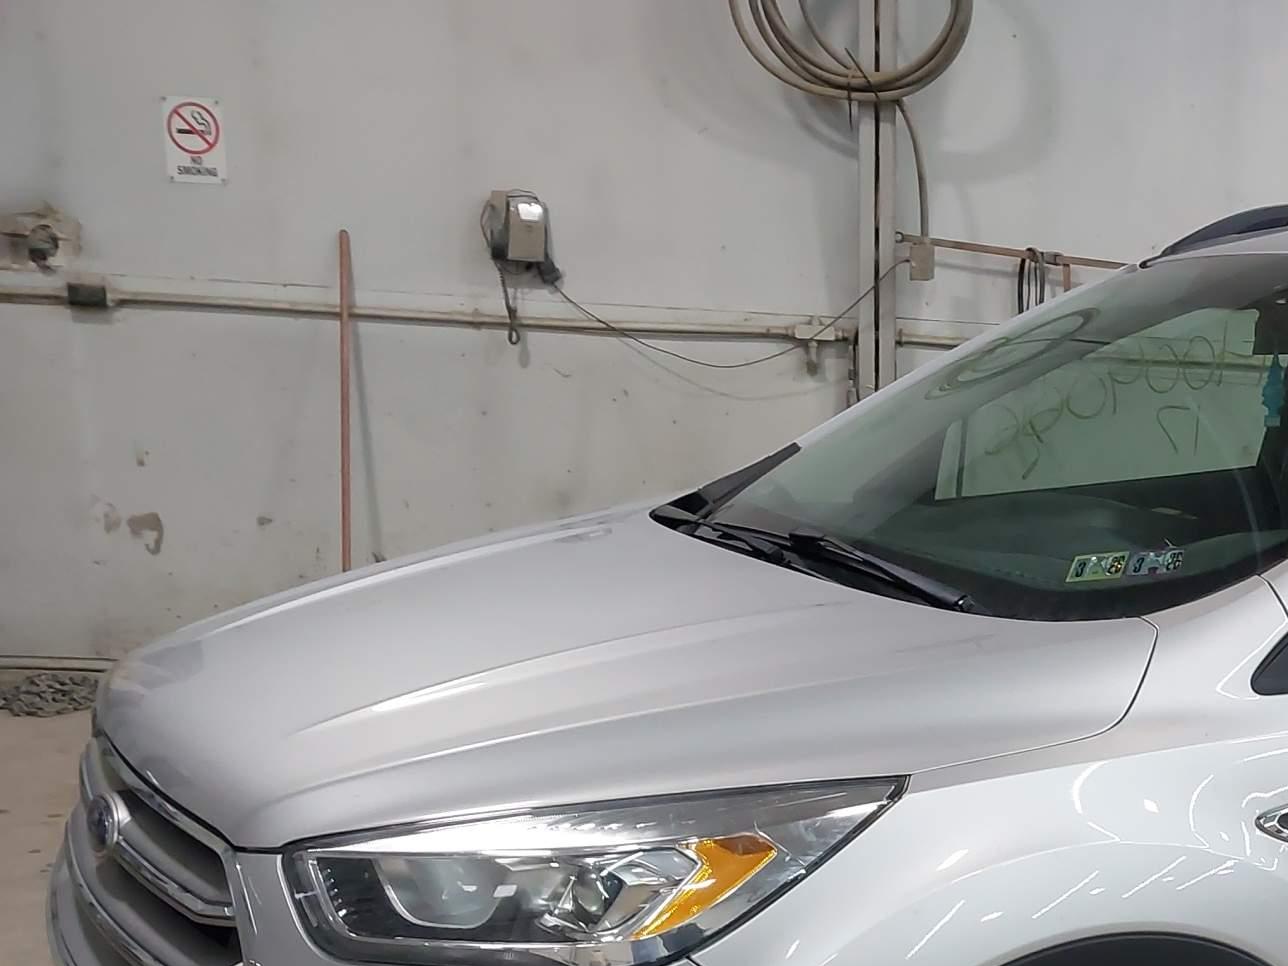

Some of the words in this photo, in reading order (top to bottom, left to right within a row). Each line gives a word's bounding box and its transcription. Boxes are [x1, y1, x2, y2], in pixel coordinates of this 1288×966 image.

[190, 155, 203, 166] NO
[1075, 561, 1087, 578] 3
[1132, 556, 1146, 574] 3
